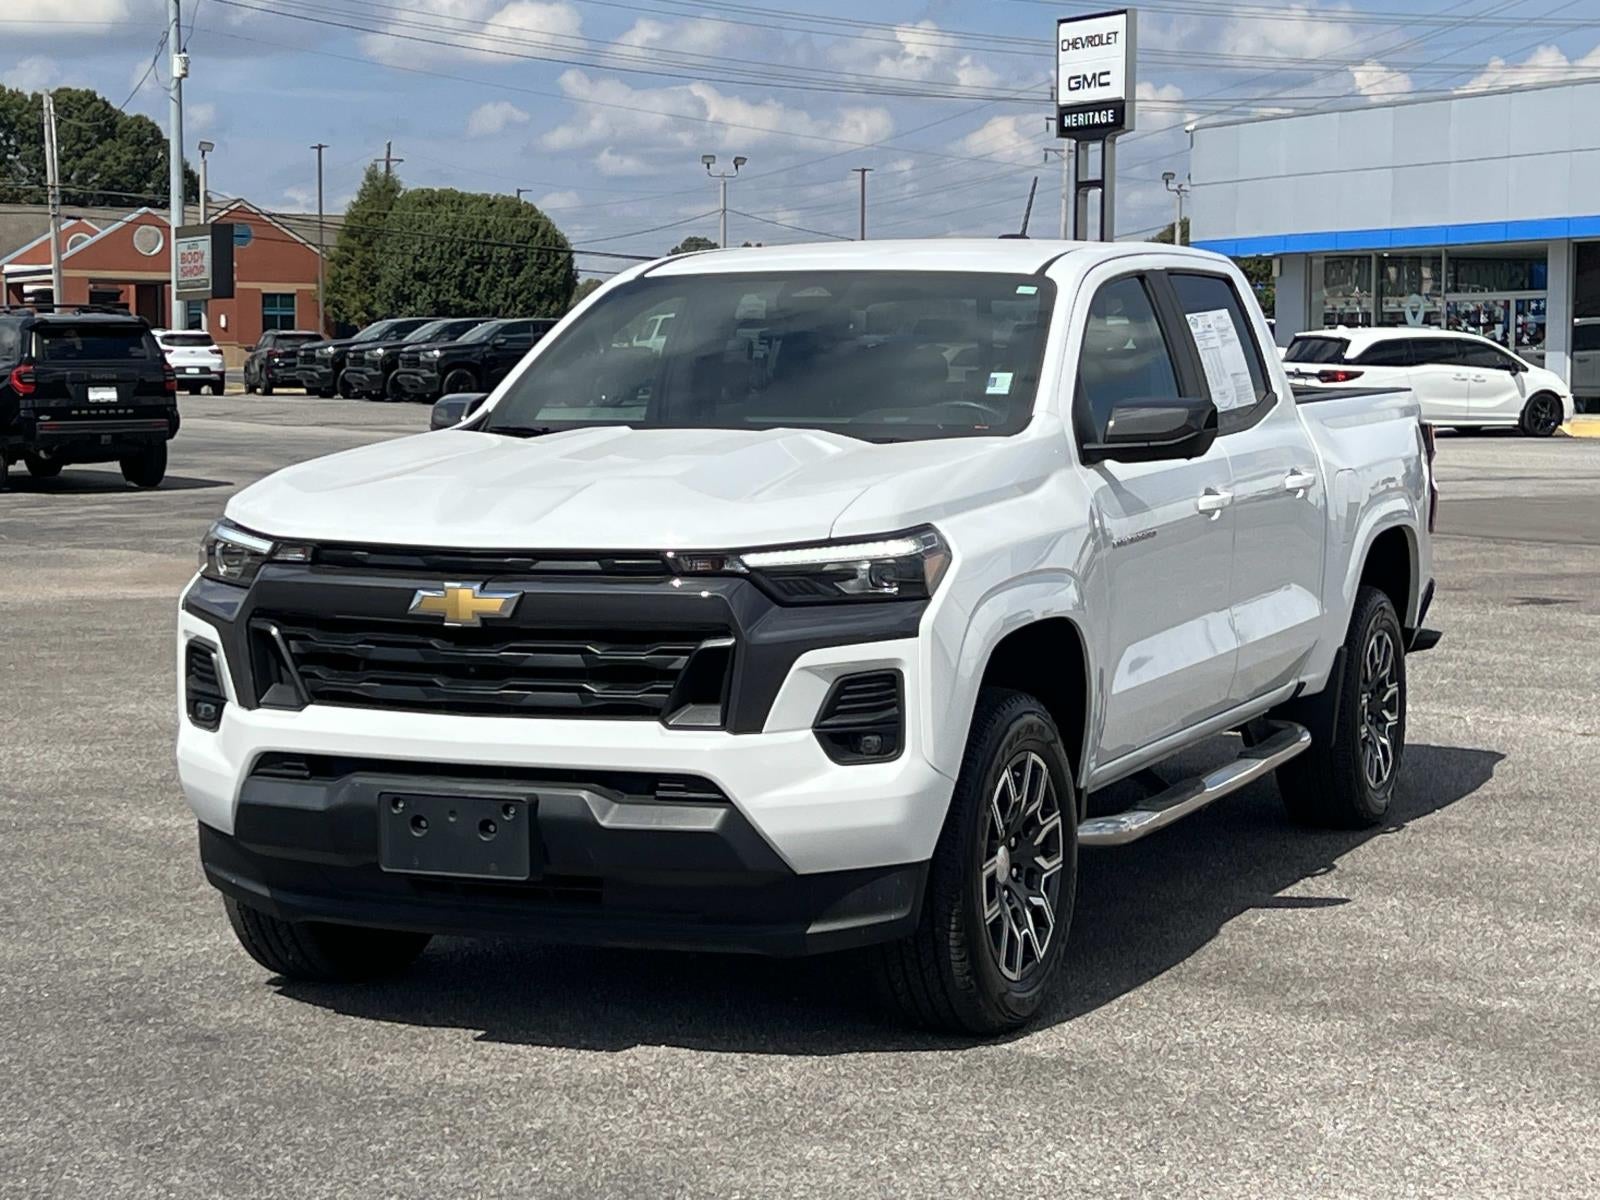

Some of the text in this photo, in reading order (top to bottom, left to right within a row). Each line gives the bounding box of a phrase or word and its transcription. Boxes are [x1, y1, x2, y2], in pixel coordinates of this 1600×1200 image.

[1061, 31, 1118, 52] CHEVROLET
[1068, 71, 1111, 91] GMC
[1064, 109, 1115, 127] HERITAGE
[181, 250, 205, 264] BODY
[181, 265, 205, 278] SHOP
